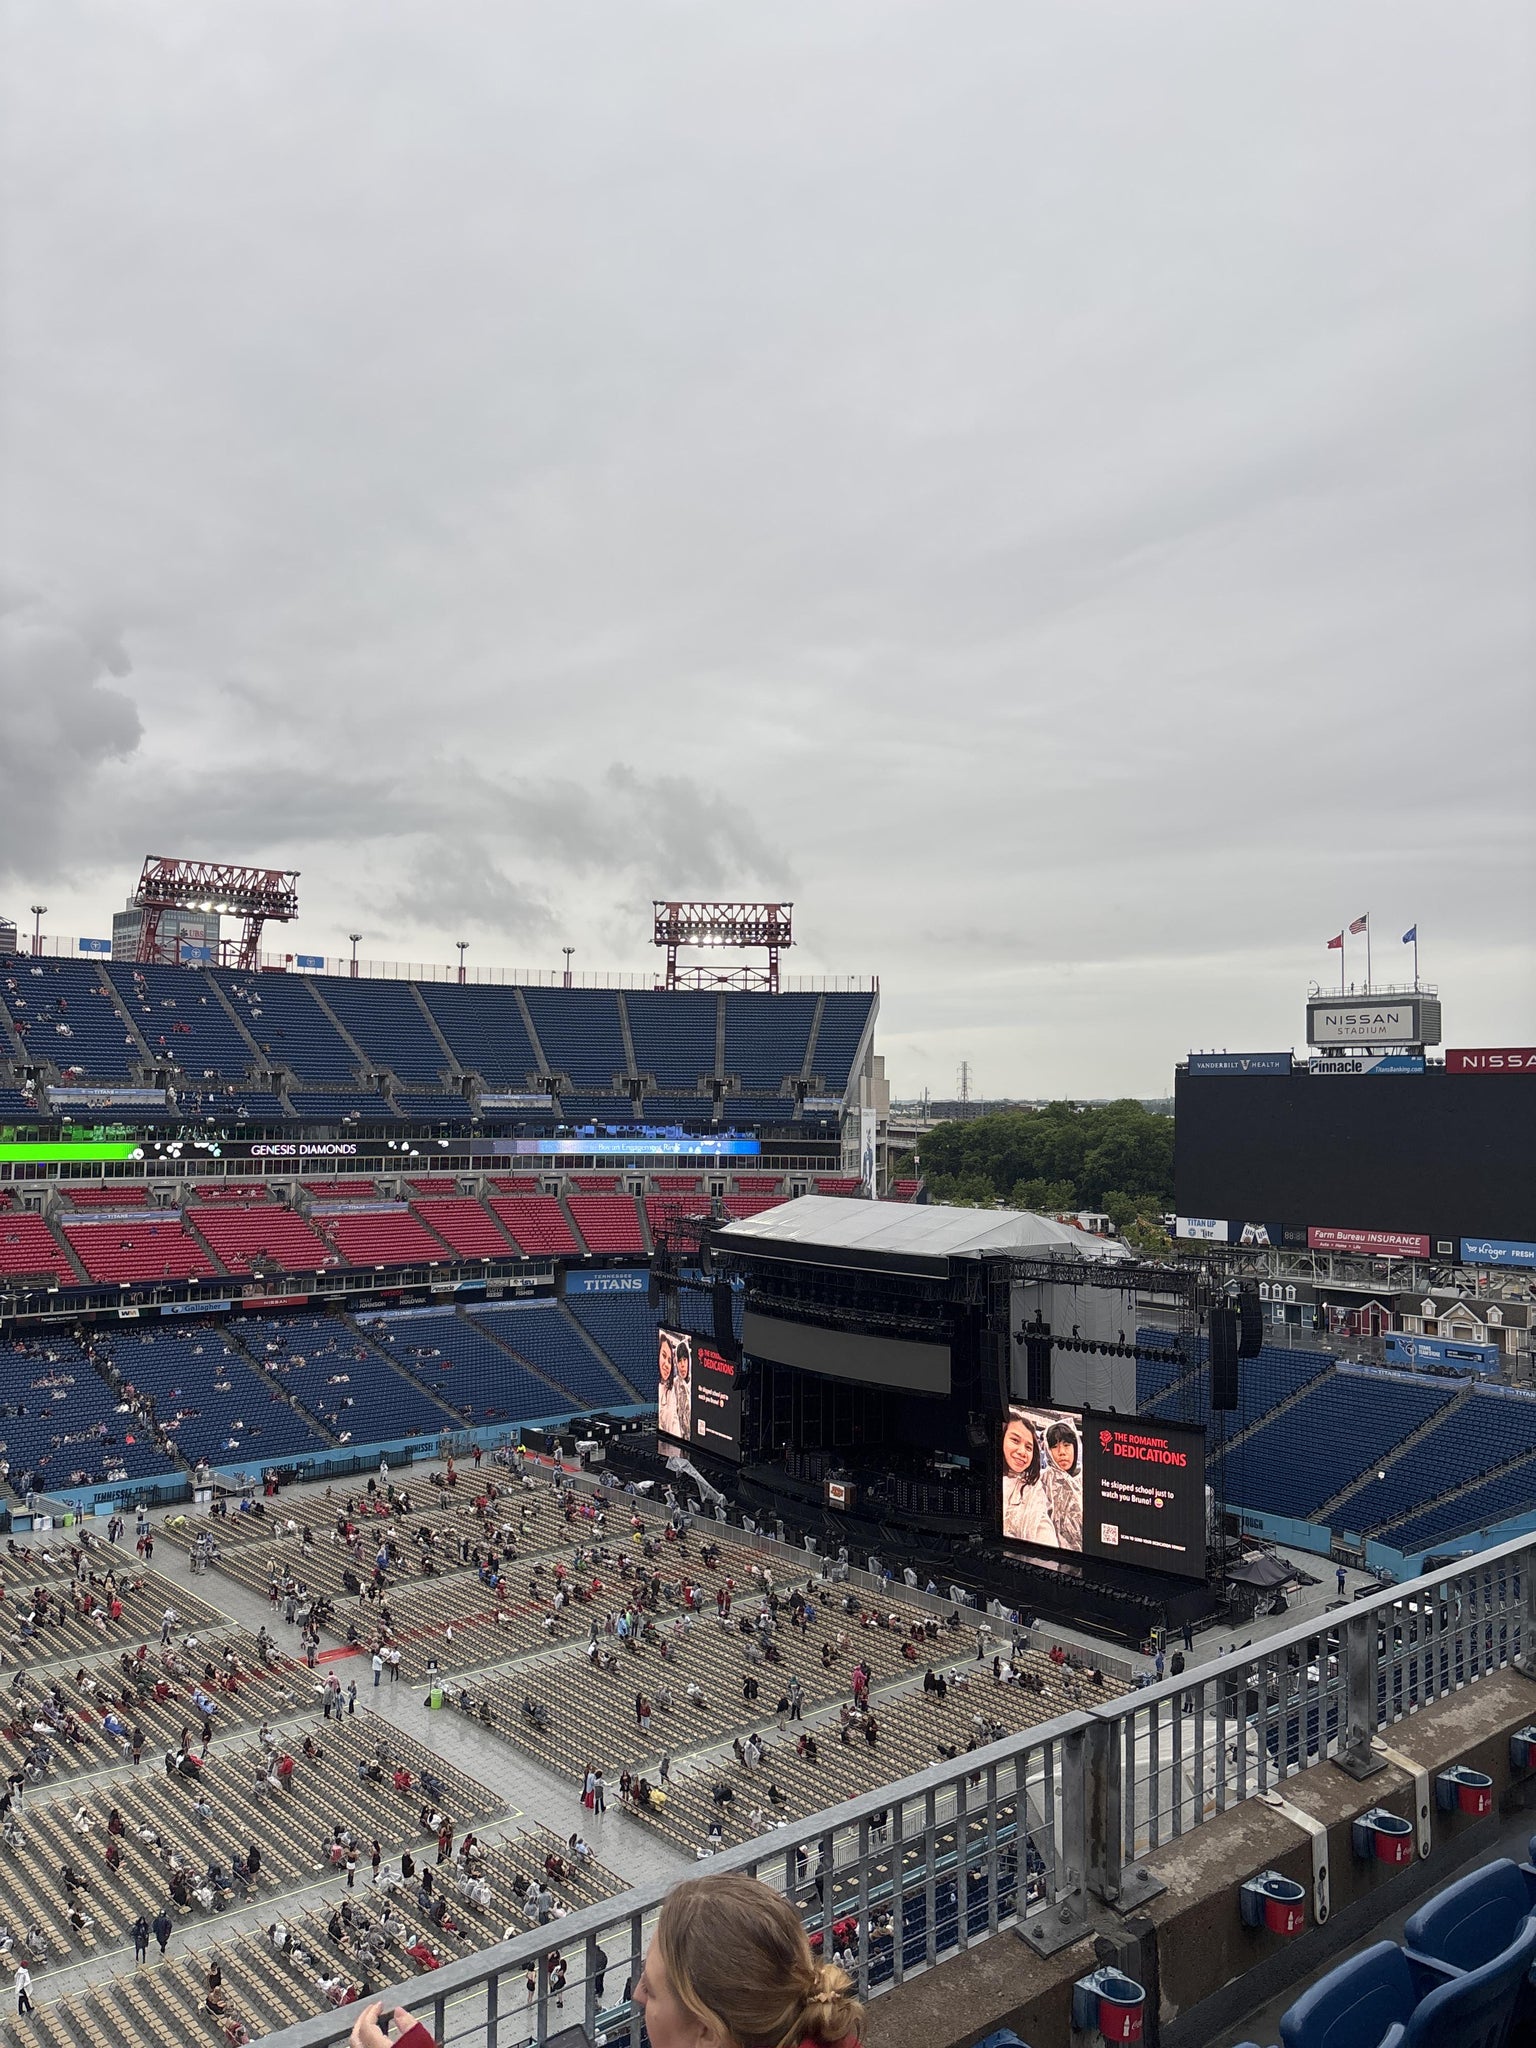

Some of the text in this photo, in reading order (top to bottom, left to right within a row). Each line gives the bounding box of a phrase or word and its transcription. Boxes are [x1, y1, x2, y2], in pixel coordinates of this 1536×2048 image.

[189, 929, 205, 937] UBS
[1326, 1013, 1399, 1025] NISSAN
[1337, 1027, 1388, 1035] STADIUM
[1310, 1060, 1423, 1074] Pinnacle TitansBanking.com
[251, 1143, 357, 1155] GENESIS DIAMONDS
[1187, 1218, 1206, 1227] TITAN
[1314, 1230, 1422, 1246] Farm Bureau INSURANCE
[1478, 1243, 1535, 1260] Kroger FRESH
[583, 1278, 643, 1291] TITANS
[185, 1304, 221, 1312] Gallagher
[359, 1301, 387, 1309] JOHNSON
[704, 1358, 735, 1376] DEDICATIONS
[1114, 1432, 1169, 1449] THE ROMANTIC
[1114, 1443, 1187, 1467] DEDICATIONS
[1101, 1479, 1174, 1499] He skipped school just to
[1101, 1491, 1152, 1506] watch you Bruno!
[712, 1827, 719, 1835] A
